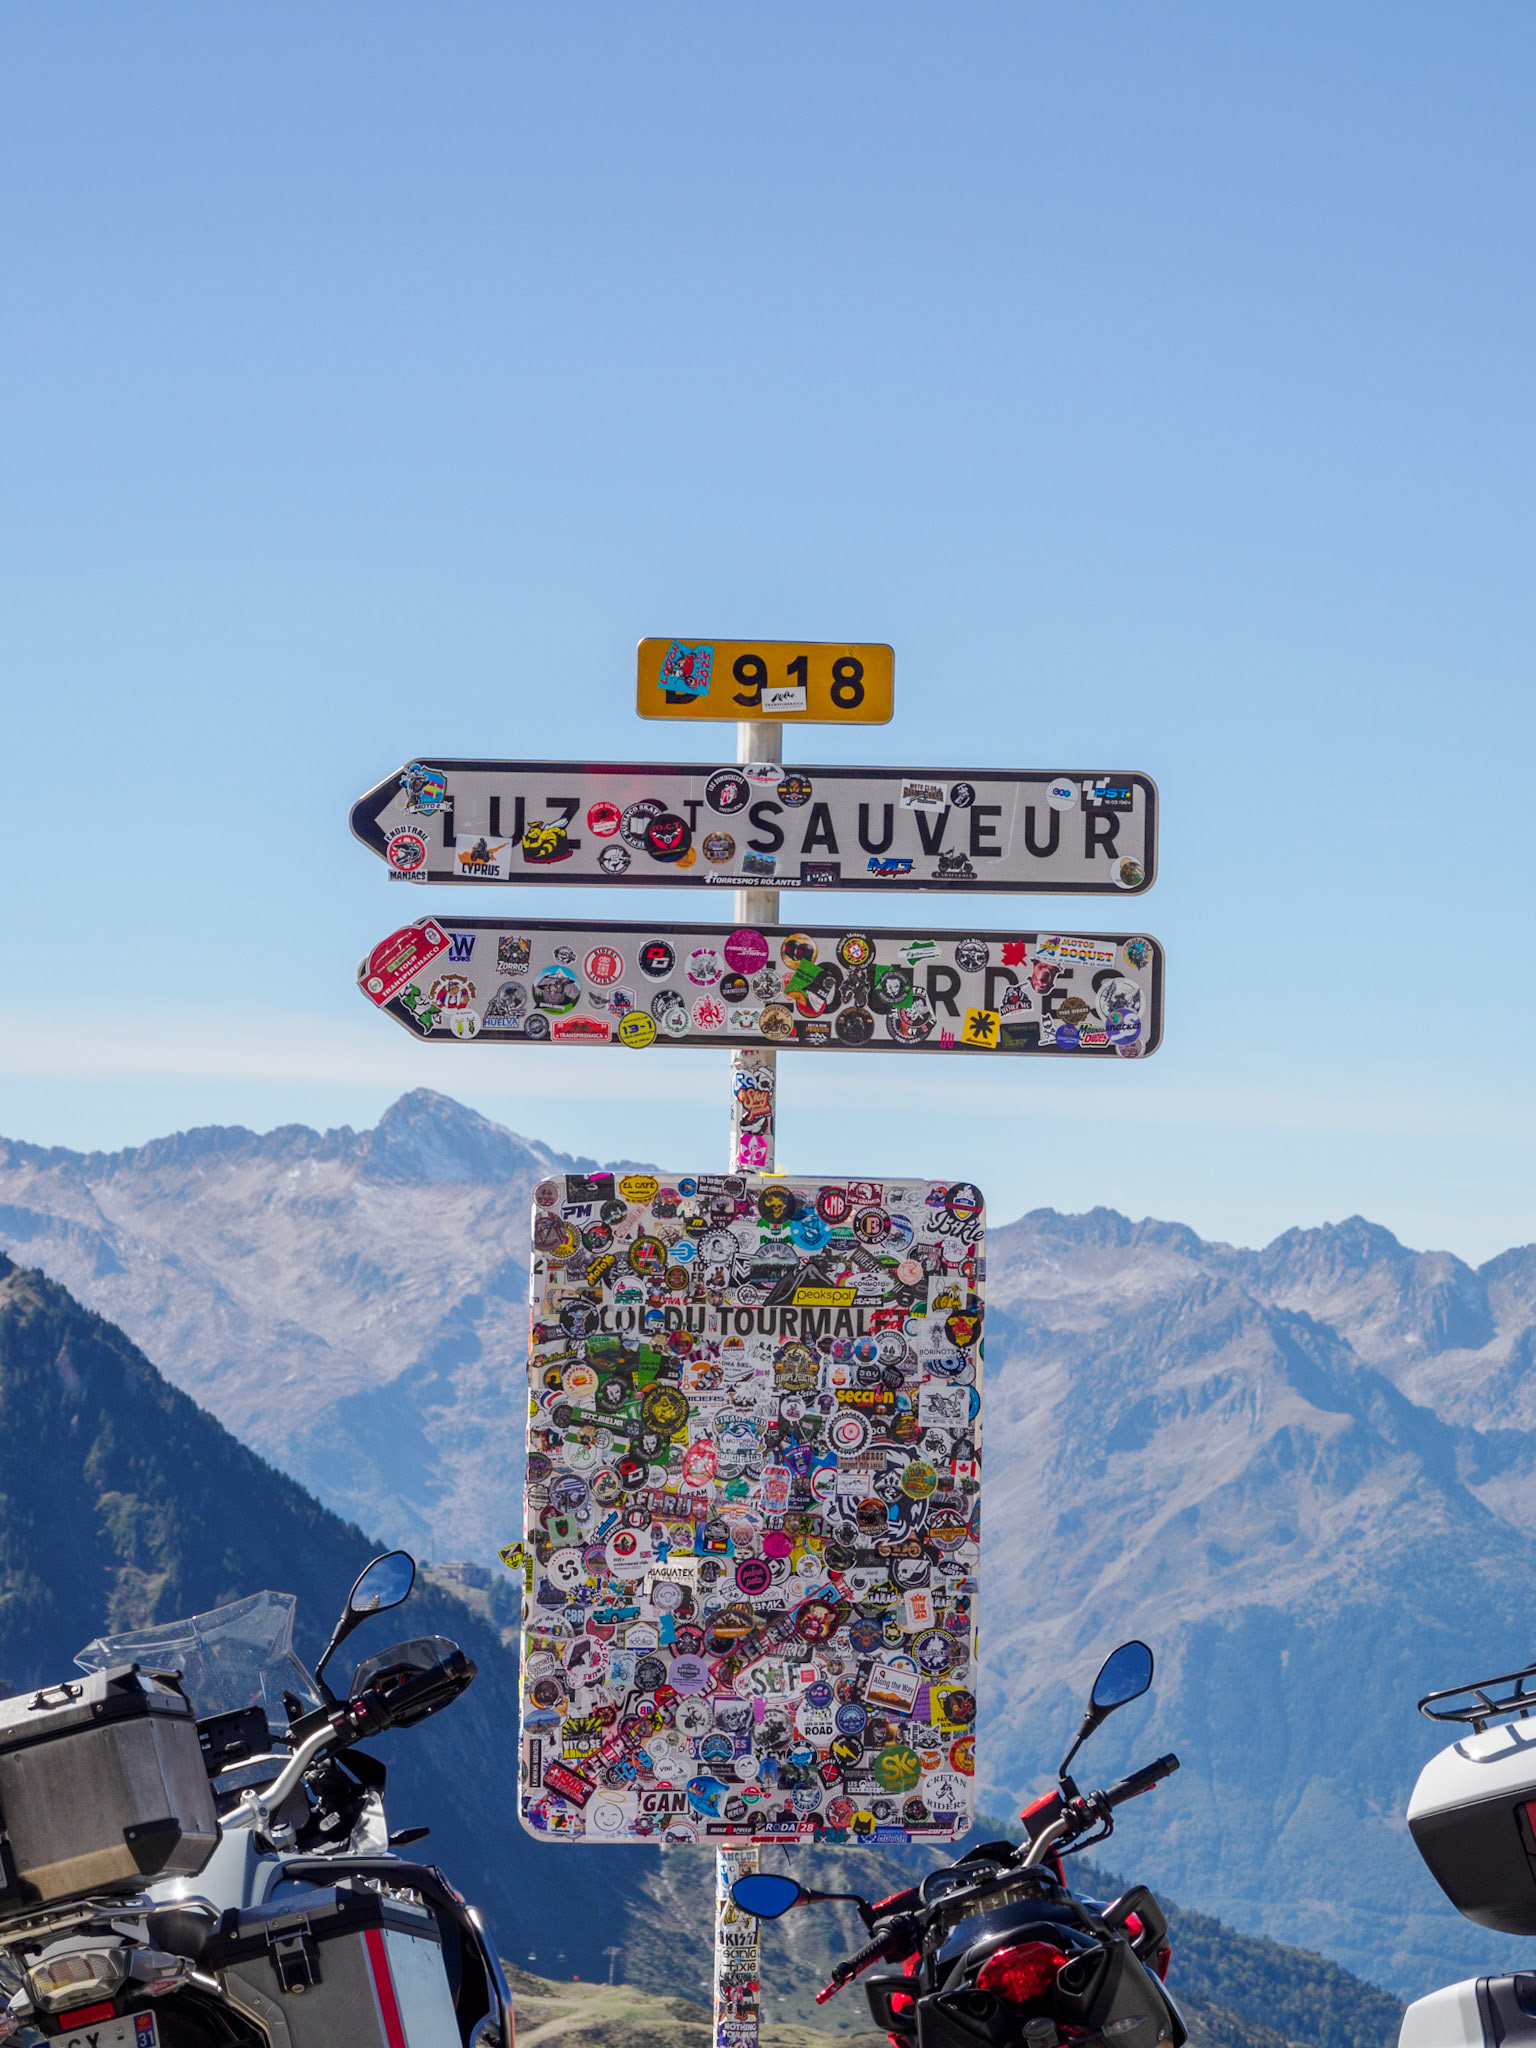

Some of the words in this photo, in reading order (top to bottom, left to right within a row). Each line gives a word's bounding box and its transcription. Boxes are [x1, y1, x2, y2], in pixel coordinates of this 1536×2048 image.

[733, 654, 864, 709] 918
[909, 783, 923, 791] MOTO
[1093, 788, 1130, 798] PST
[747, 801, 1119, 859] SAUVEUR
[389, 871, 427, 881] MANIACS
[462, 862, 501, 877] CYPRUS
[760, 877, 801, 886] ROLANTES
[1061, 938, 1095, 949] MOTOS
[1059, 947, 1114, 963] BOQUET
[382, 946, 440, 997] TRANSPIRENAICO
[399, 955, 418, 973] TOUR
[497, 961, 529, 972] ZORROS
[484, 1018, 519, 1028] HUELVA
[622, 1020, 652, 1035] 13-1
[1084, 1033, 1108, 1044] DUDES
[743, 1088, 768, 1108] Sky
[824, 1199, 845, 1215] LMB
[600, 1305, 653, 1334] COL
[665, 1306, 706, 1335] DU
[919, 1349, 956, 1357] BORINOTS
[504, 1553, 523, 1564] CLUB
[564, 1608, 585, 1623] CBR
[874, 1676, 892, 1689] Along
[891, 1680, 902, 1691] the
[901, 1682, 915, 1695] Way
[805, 1726, 833, 1736] ROAD
[531, 1740, 540, 1764] RIDERS
[881, 1752, 915, 1781] SK
[531, 1765, 540, 1787] LOBOS
[926, 1773, 968, 1789] CRETAN
[643, 1793, 687, 1813] GAN
[926, 1798, 967, 1810] RIDERS
[799, 1823, 814, 1832] 28
[723, 1949, 757, 1959] santa
[723, 1960, 757, 1972] fixie
[722, 2030, 758, 2038] TOULOUSE
[724, 2022, 757, 2031] NOTHING
[138, 2030, 157, 2047] 31
